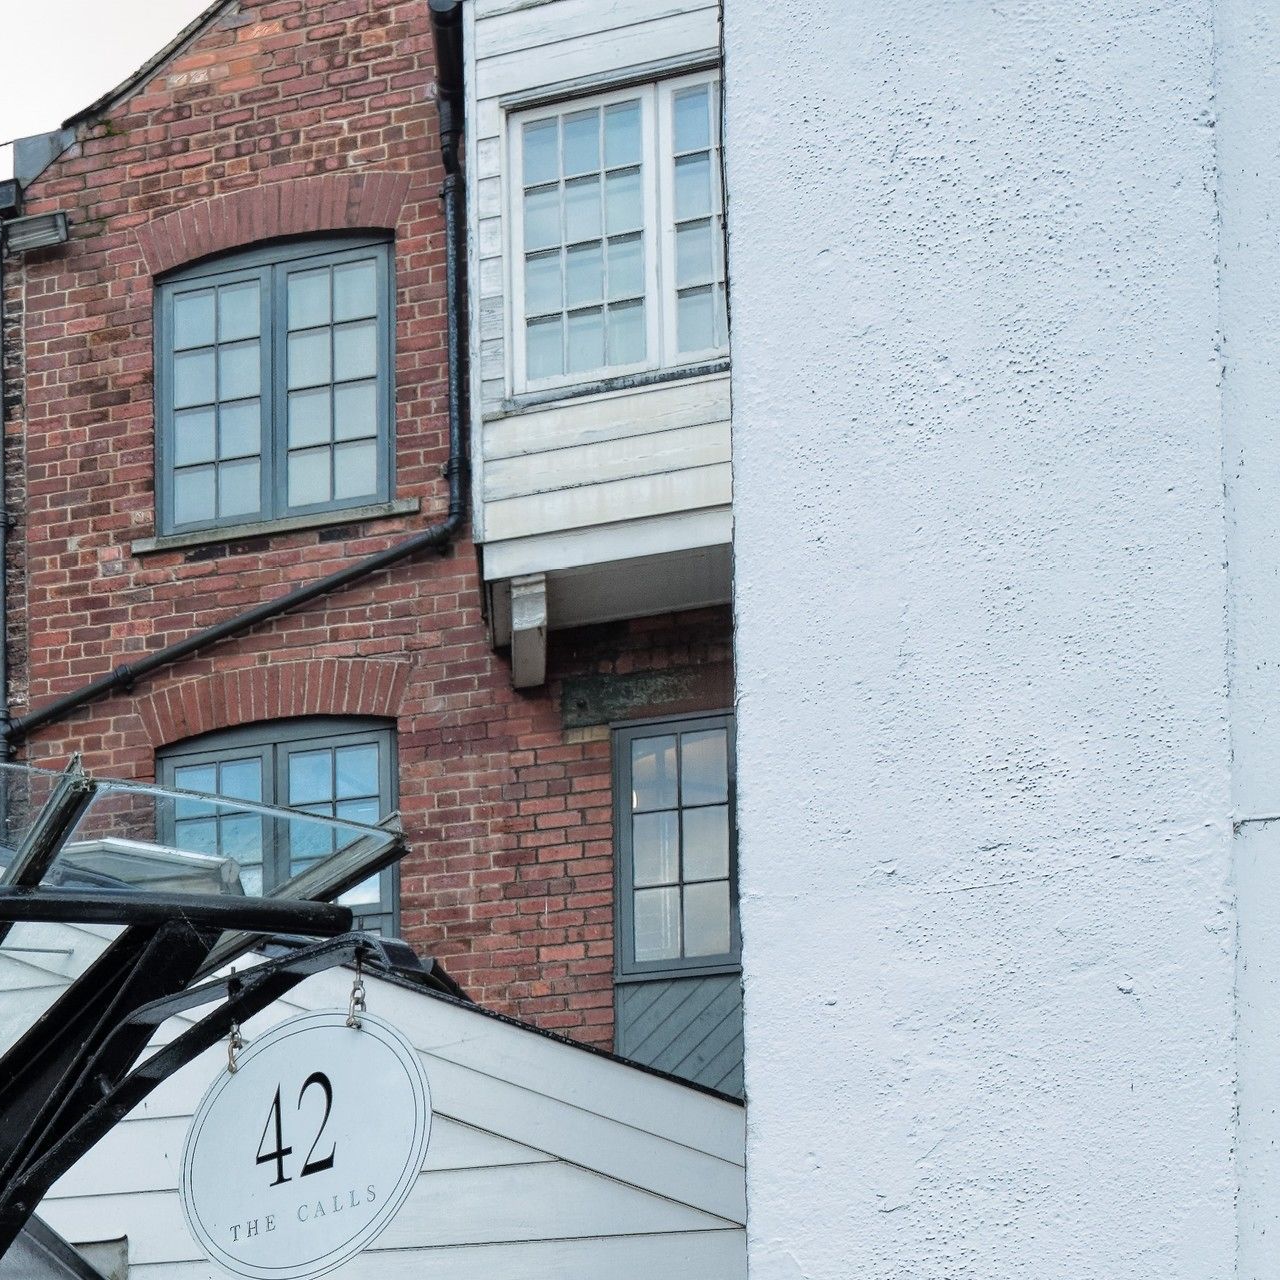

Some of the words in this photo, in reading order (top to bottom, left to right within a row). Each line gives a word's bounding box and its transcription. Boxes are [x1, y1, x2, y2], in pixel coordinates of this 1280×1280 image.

[255, 1071, 336, 1188] 42
[229, 1214, 276, 1243] THE
[296, 1184, 377, 1223] CALLS
